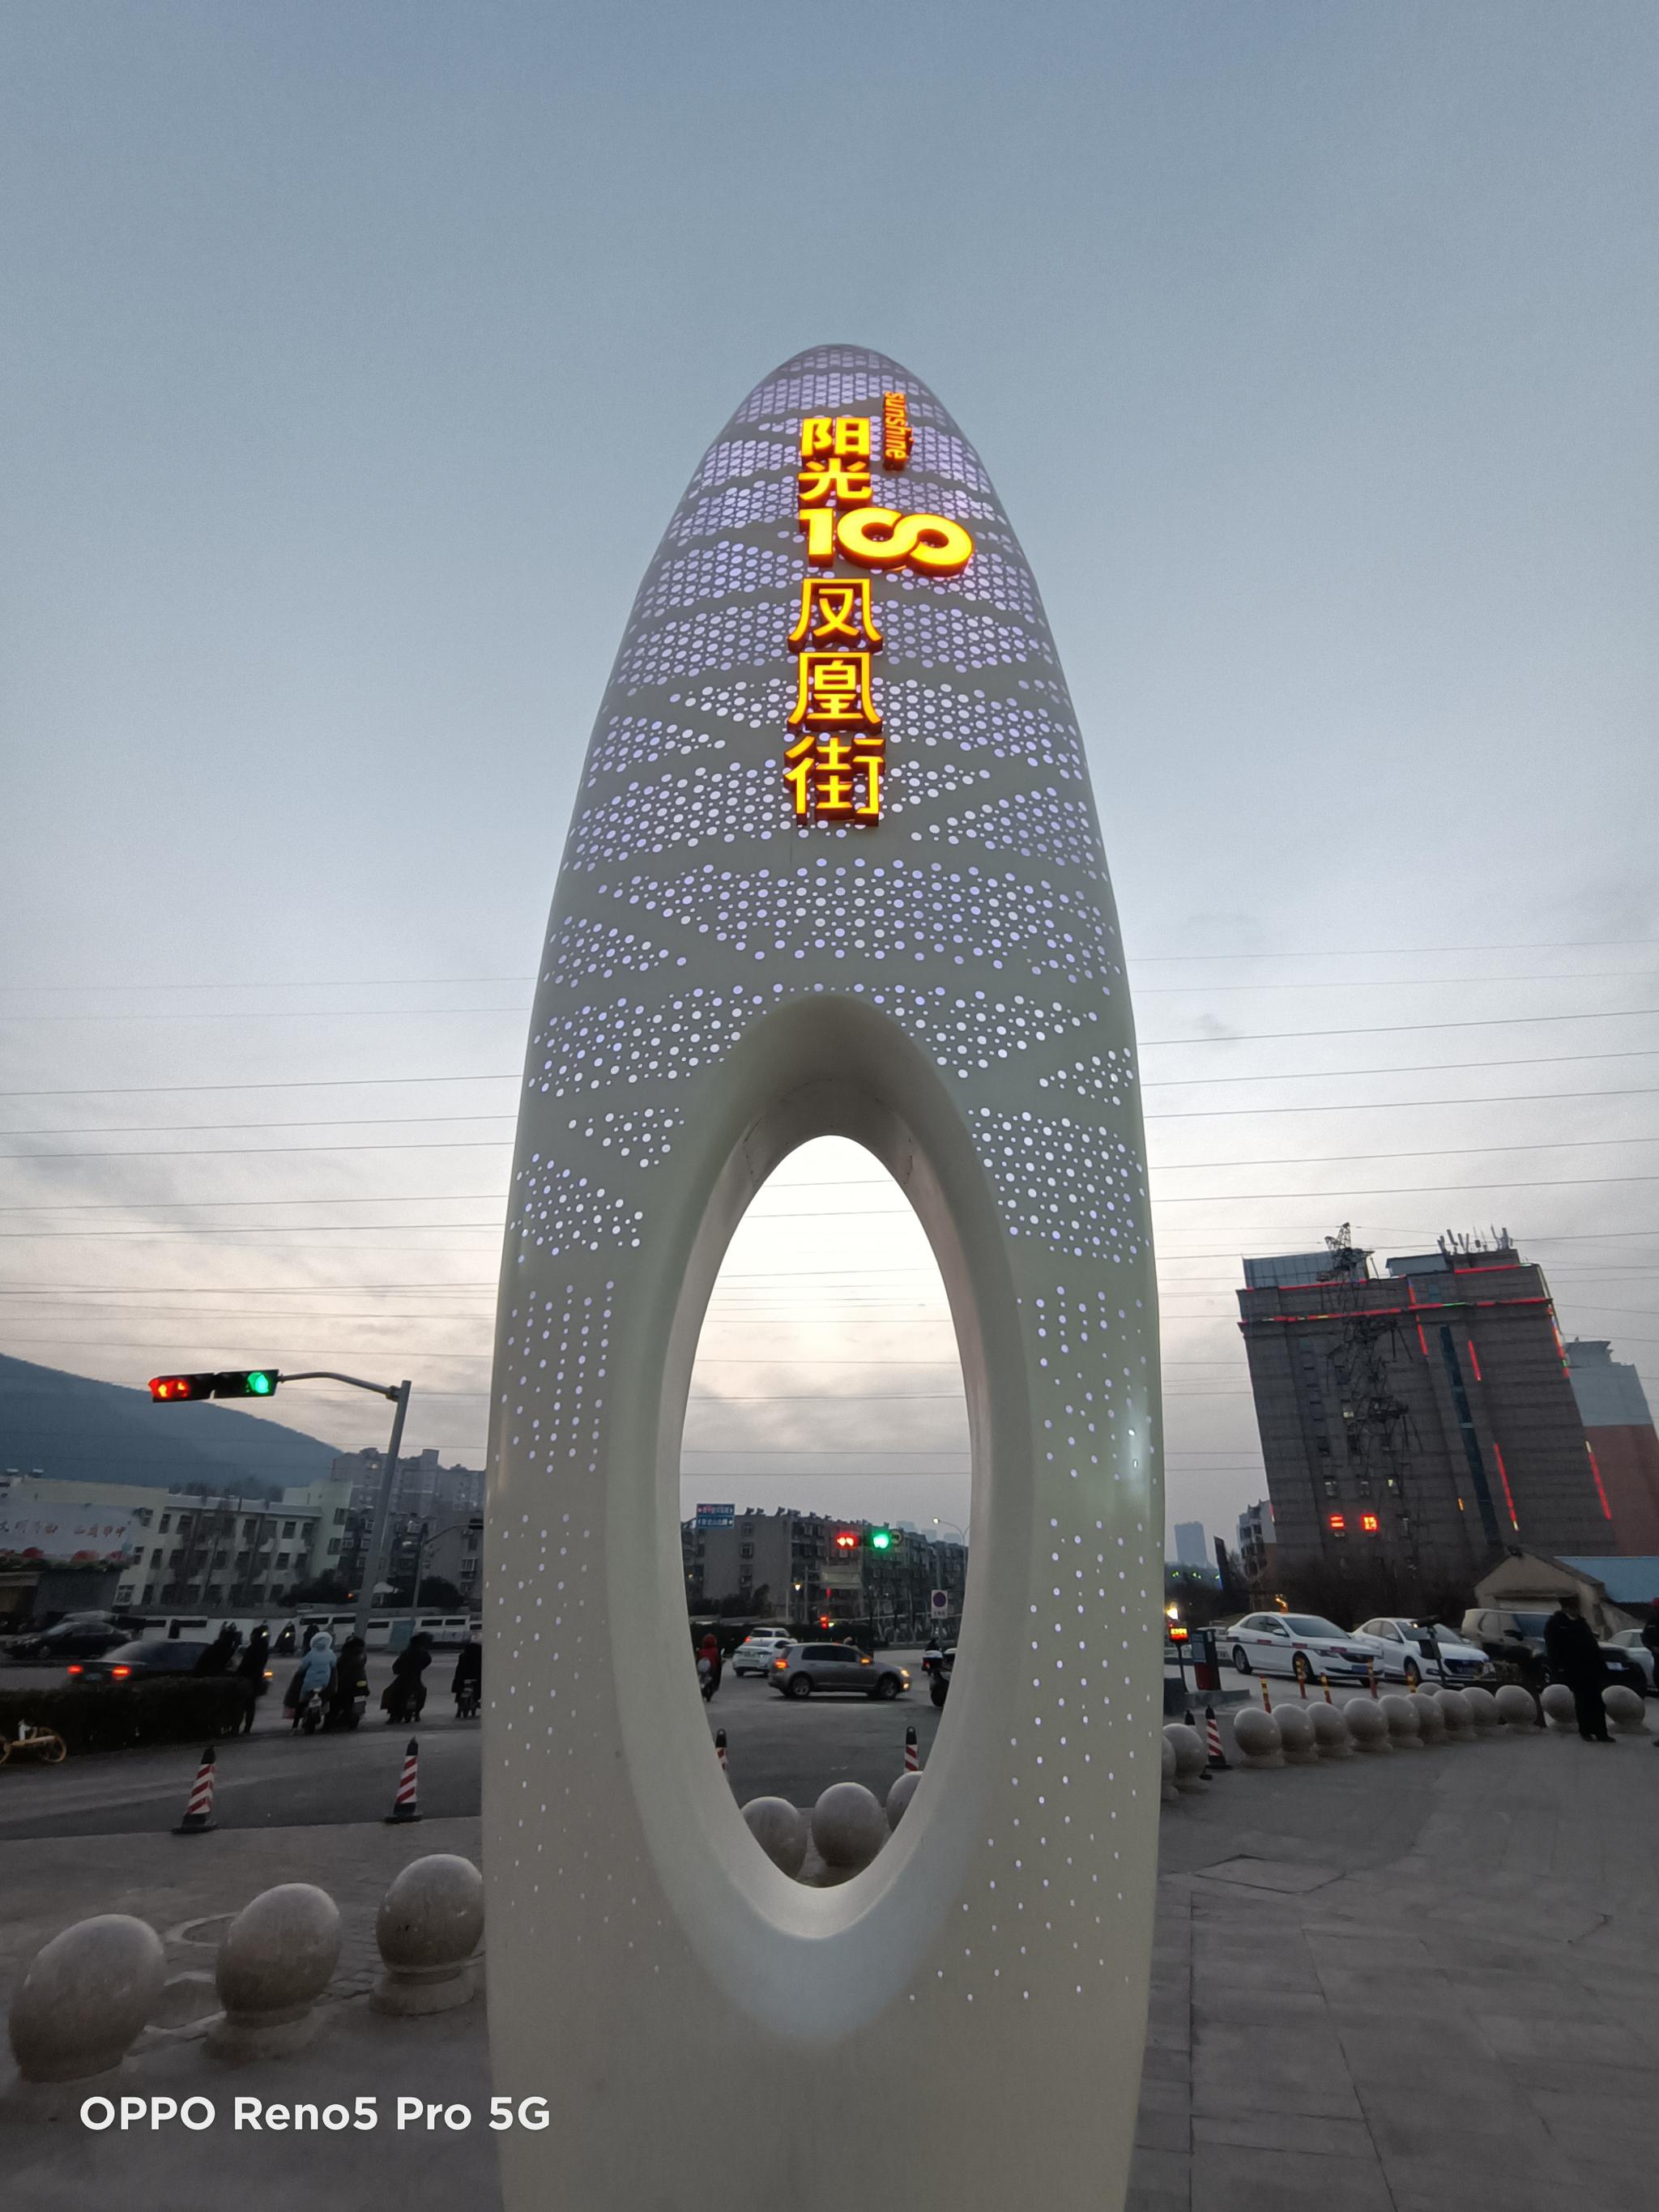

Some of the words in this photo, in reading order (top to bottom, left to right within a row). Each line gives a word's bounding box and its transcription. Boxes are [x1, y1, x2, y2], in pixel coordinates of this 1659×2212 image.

[798, 416, 873, 502] 阳光
[884, 390, 913, 460] sunshine
[798, 507, 973, 566] 100
[784, 578, 885, 816] 凤凰街
